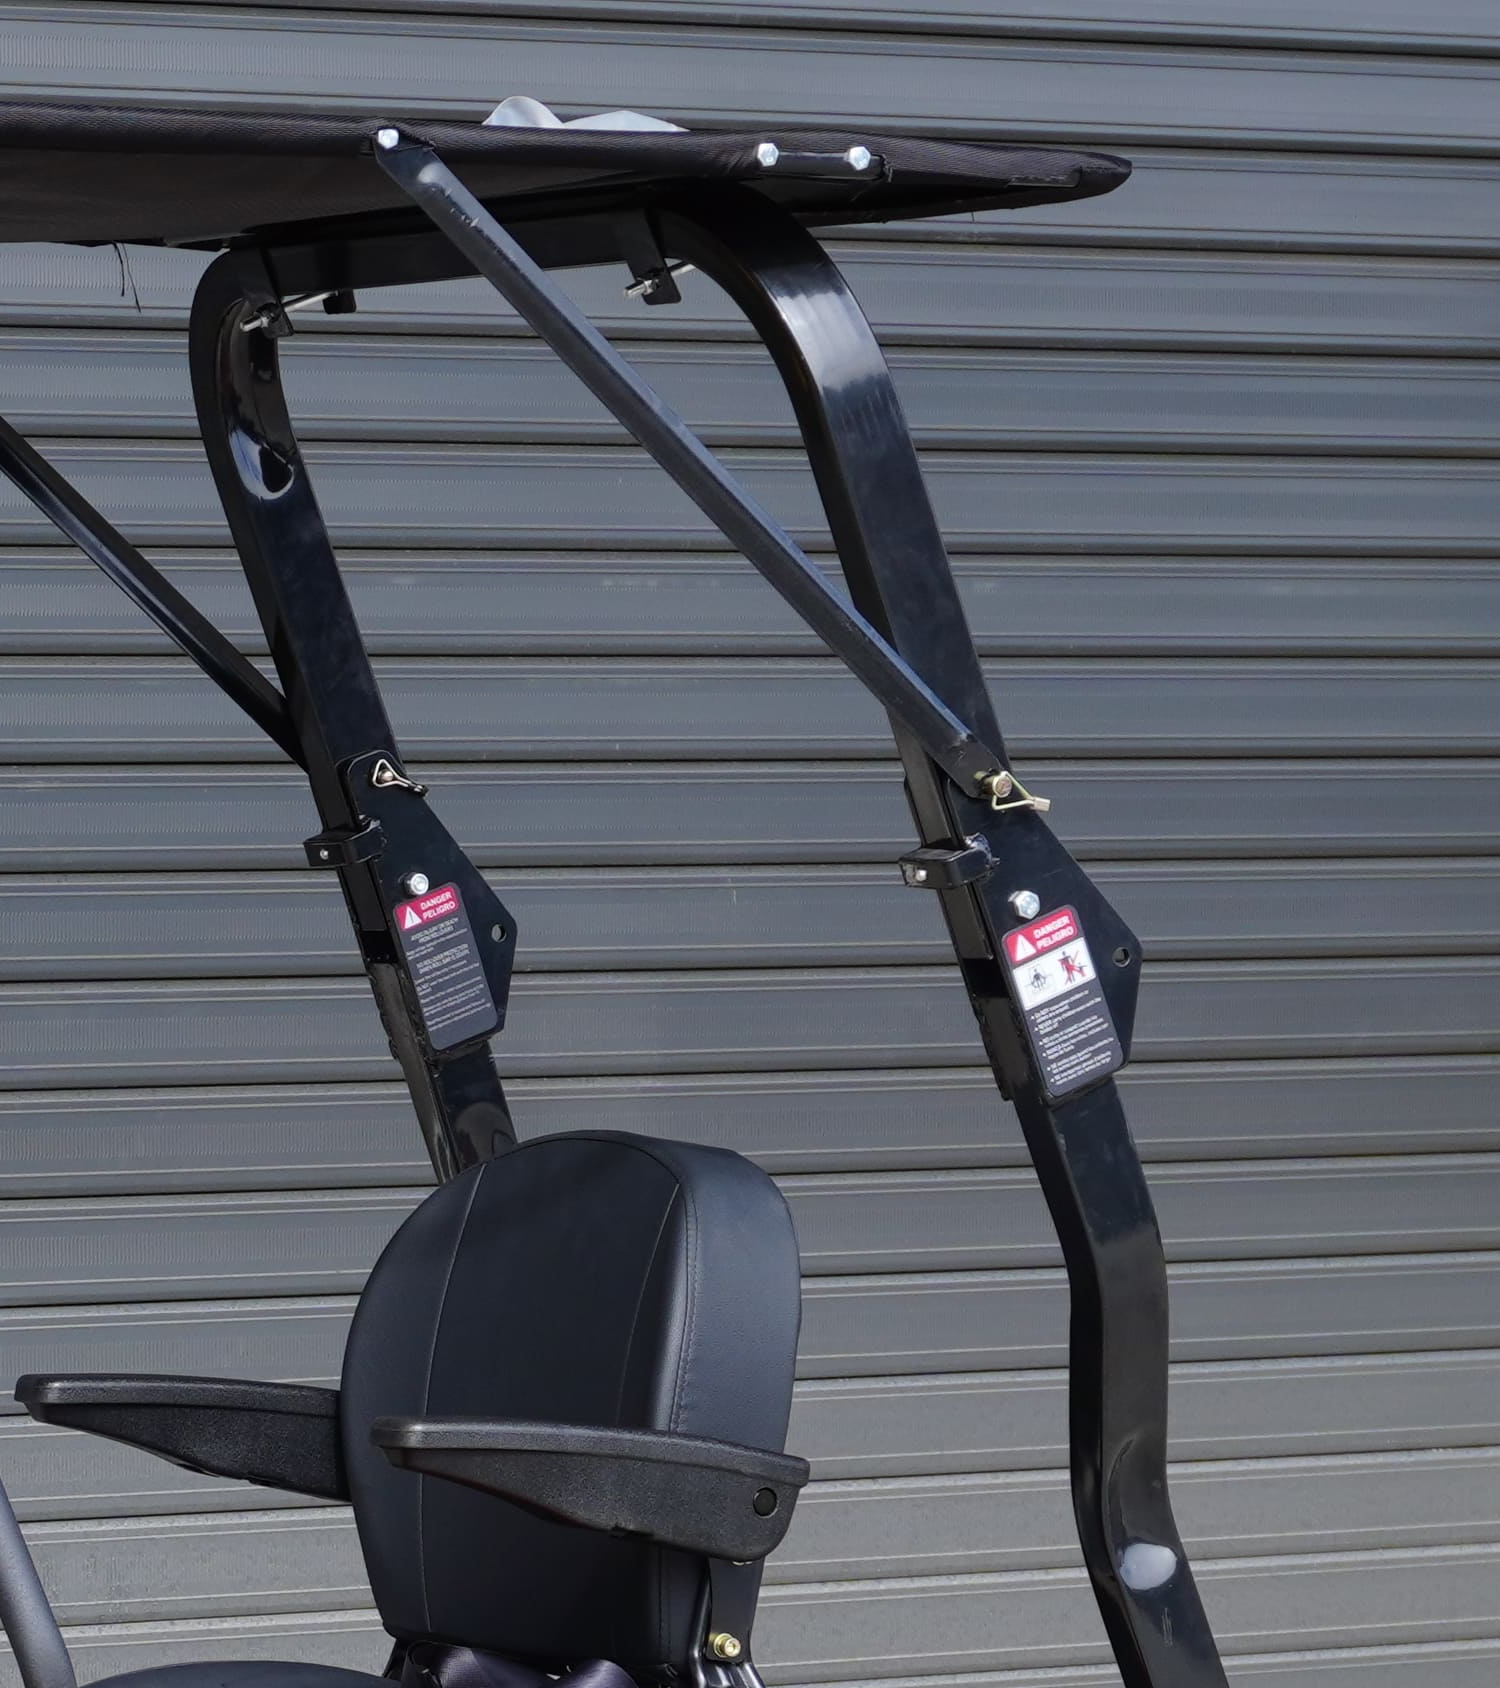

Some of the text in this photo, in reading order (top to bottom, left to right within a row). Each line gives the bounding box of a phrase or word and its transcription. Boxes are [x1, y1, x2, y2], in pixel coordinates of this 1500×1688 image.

[420, 891, 453, 910] DANGER
[422, 901, 456, 921] PELIGRO
[1034, 915, 1070, 939] DANGER
[1036, 926, 1075, 950] PELIGRO
